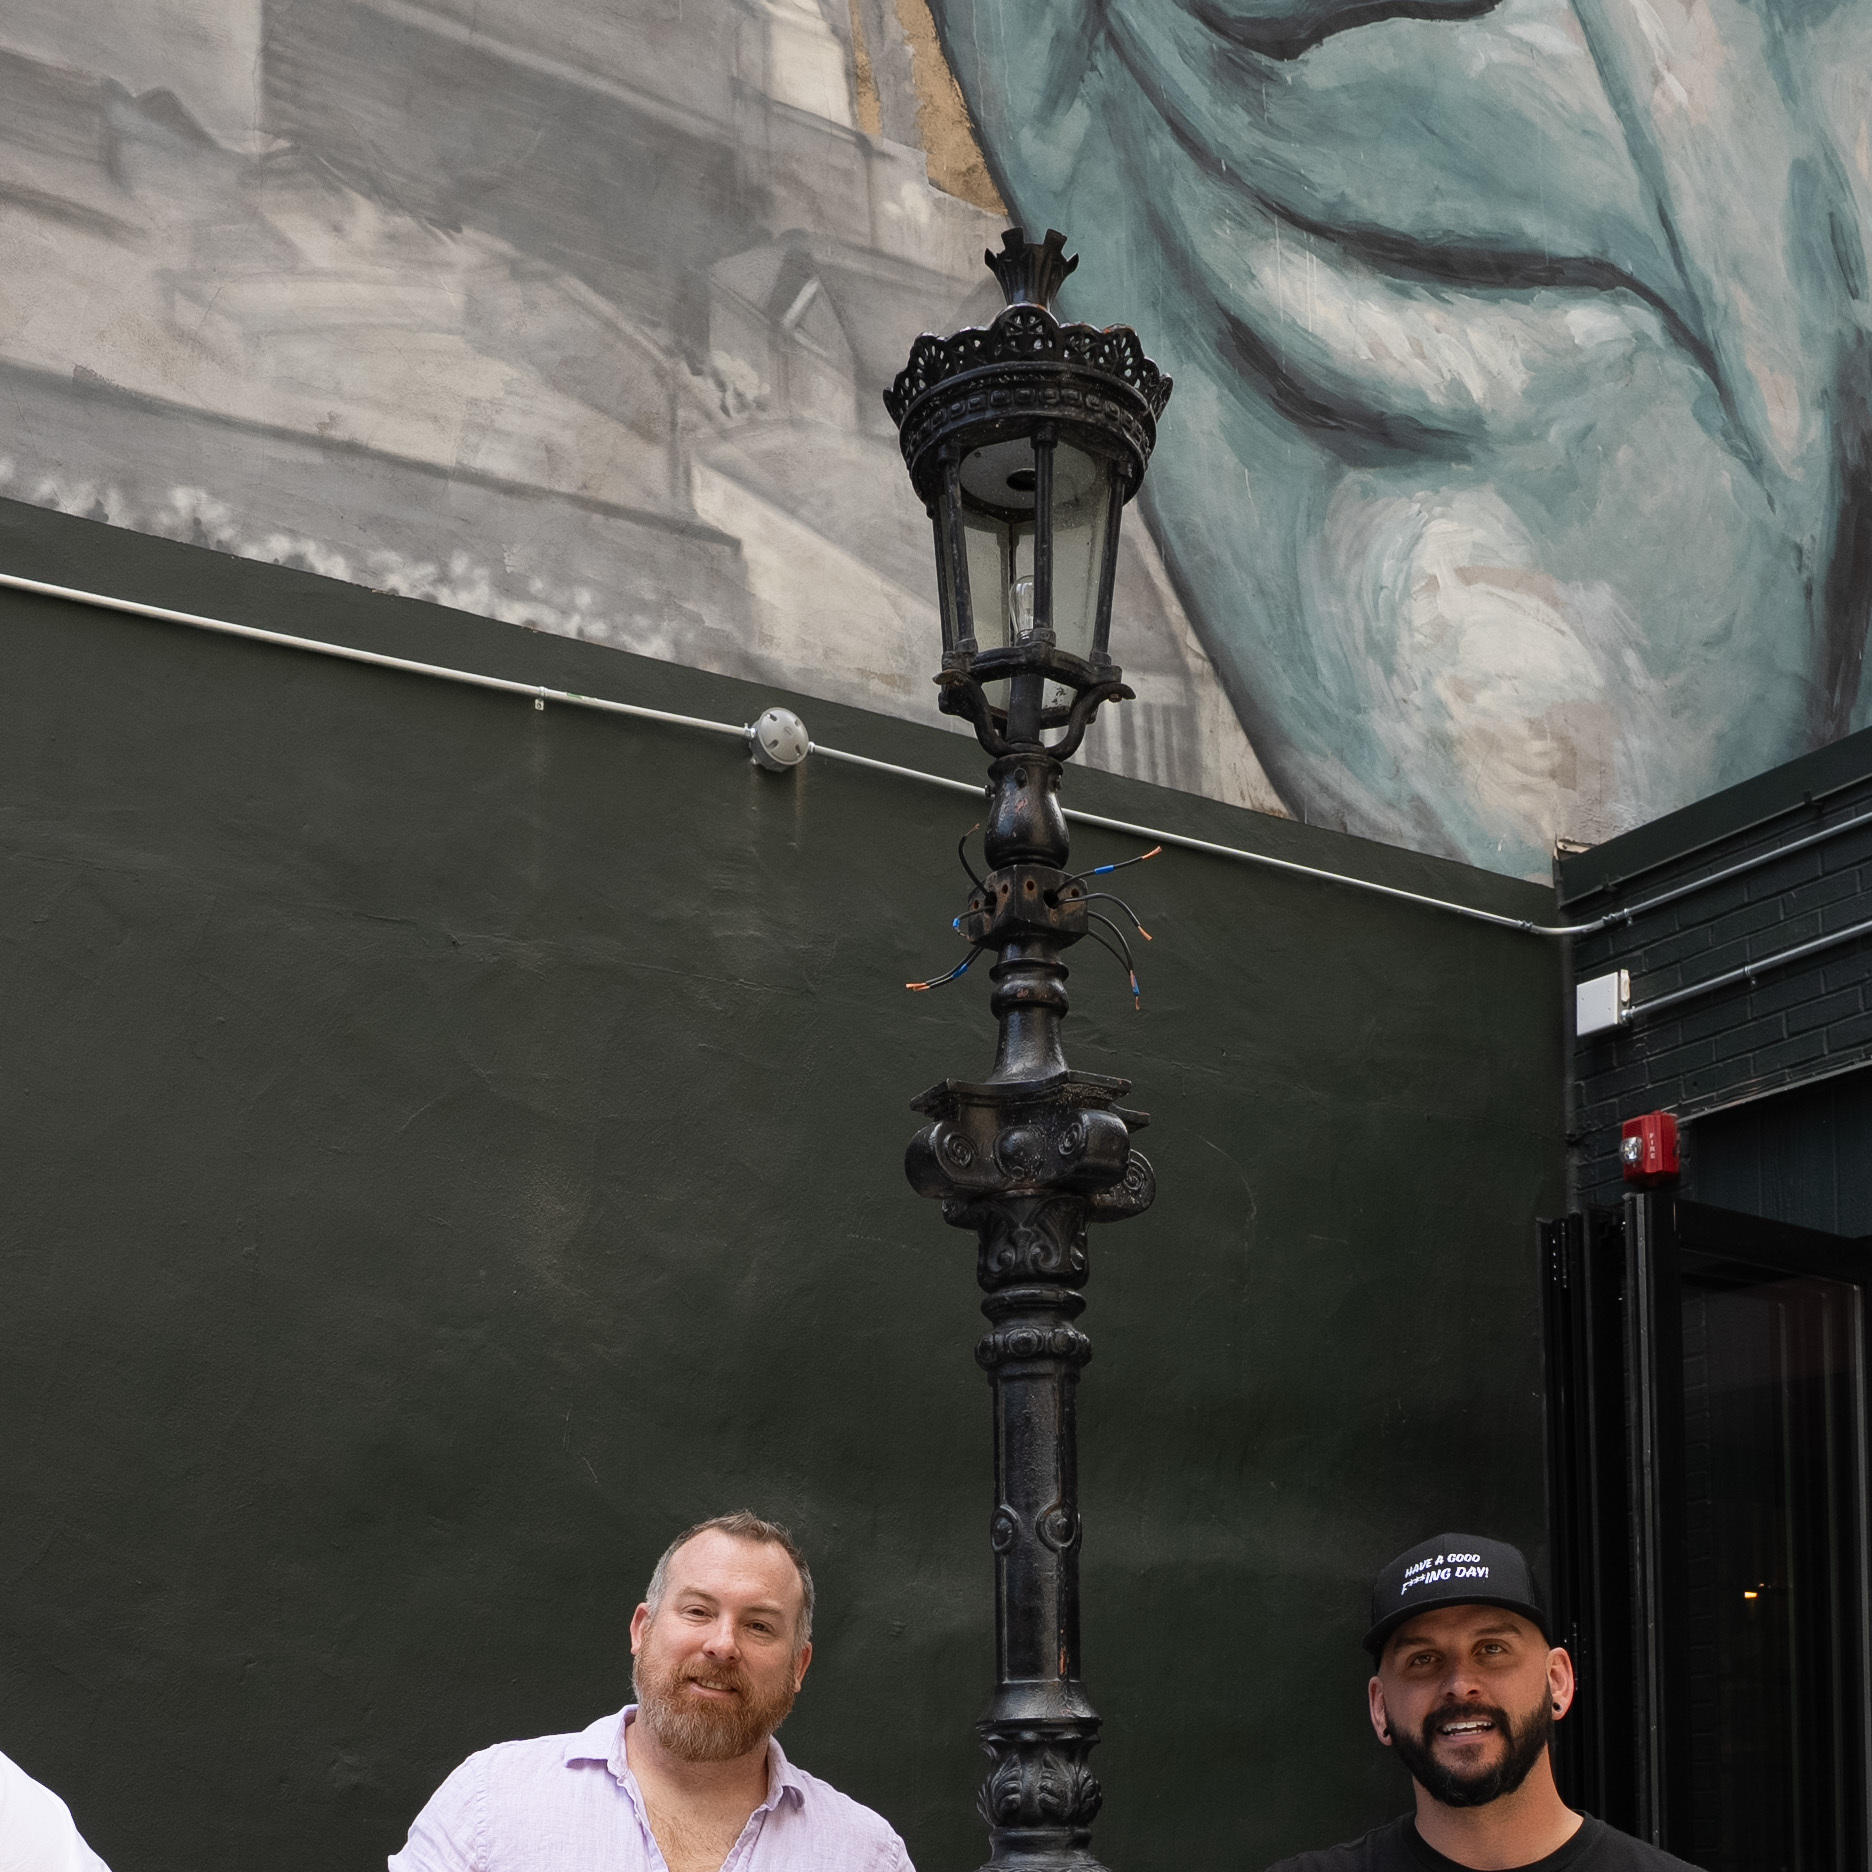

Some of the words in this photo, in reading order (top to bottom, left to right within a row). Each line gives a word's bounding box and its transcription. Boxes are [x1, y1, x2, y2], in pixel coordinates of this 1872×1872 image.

[1404, 1558, 1433, 1578] HAVE
[1435, 1554, 1445, 1566] A
[1447, 1553, 1481, 1563] GOOD
[1454, 1566, 1489, 1578] DAY!
